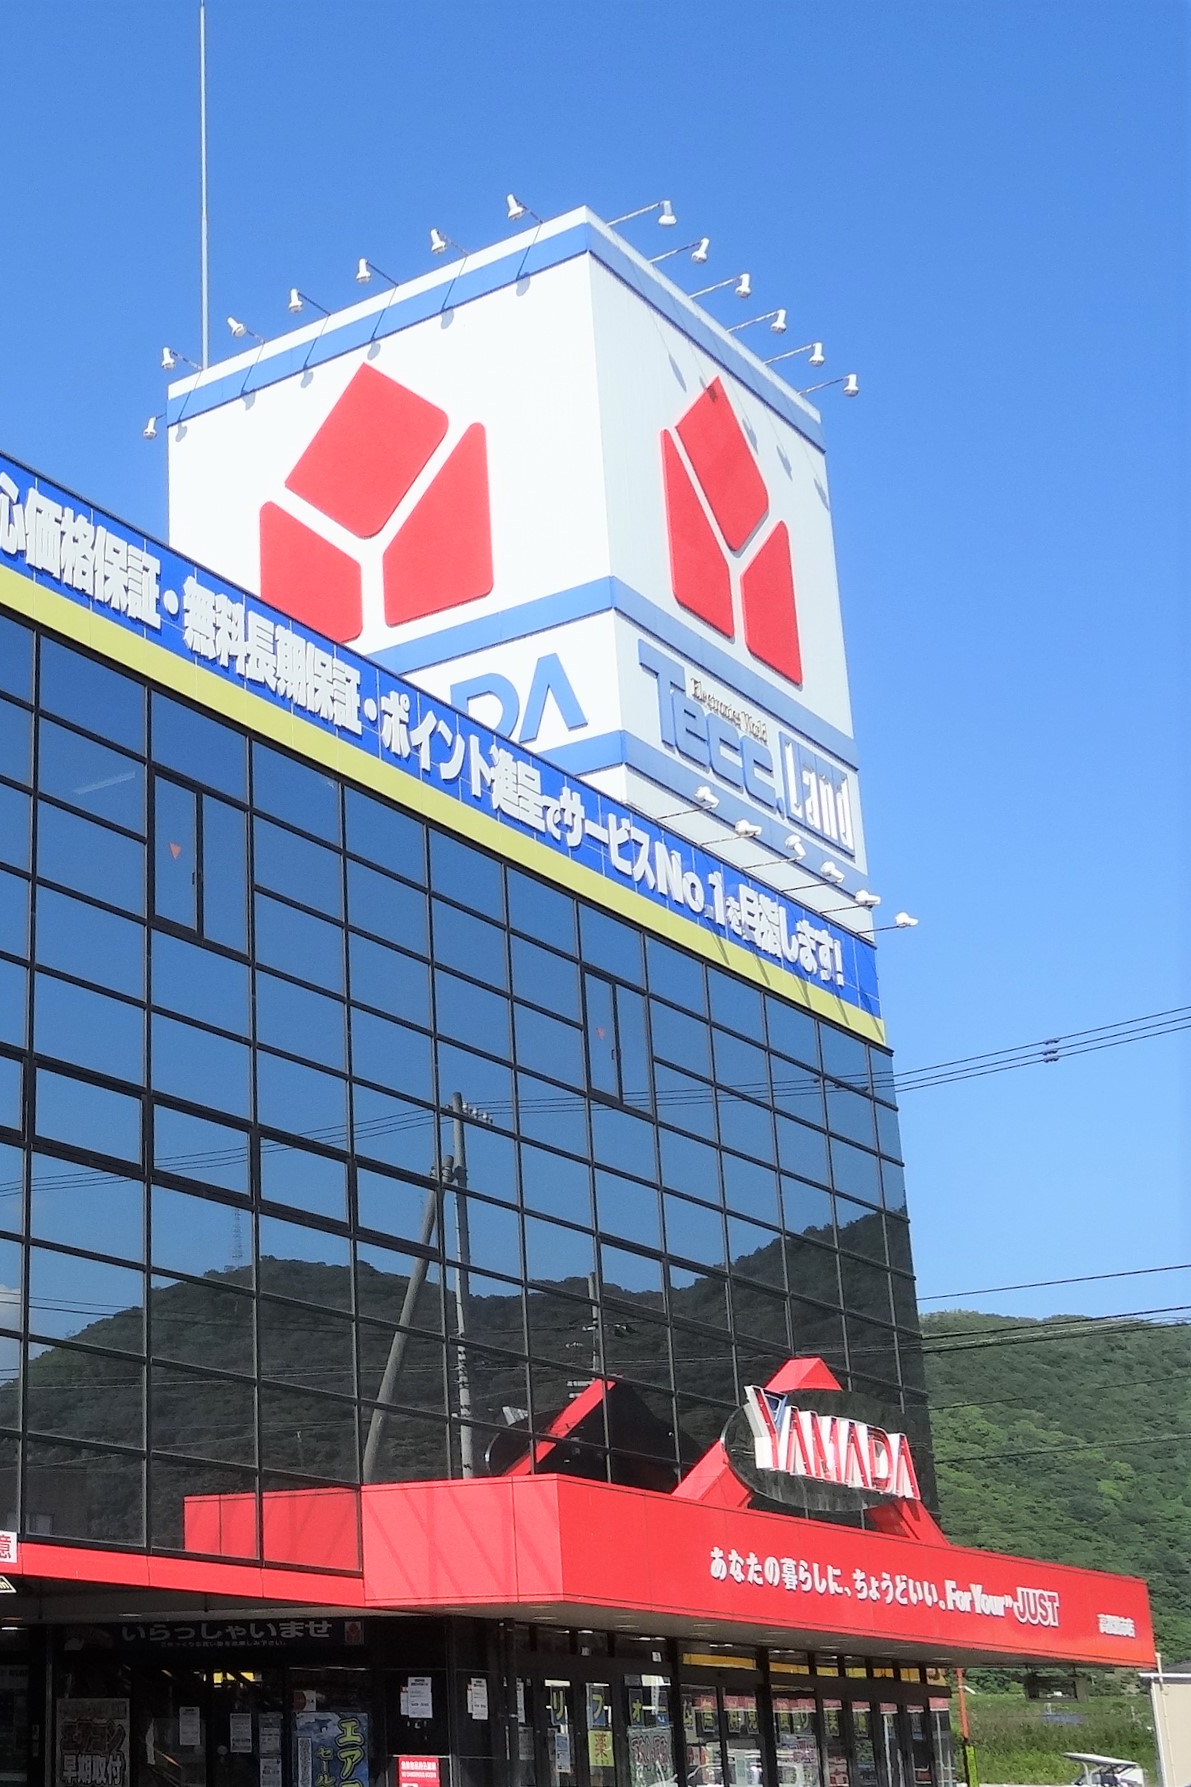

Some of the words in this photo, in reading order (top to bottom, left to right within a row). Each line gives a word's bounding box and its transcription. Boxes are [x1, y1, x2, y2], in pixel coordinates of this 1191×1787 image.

[744, 1385, 921, 1500] YAMADA
[121, 1620, 332, 1642] いらっしゃいませ
[336, 1718, 364, 1787] エア
